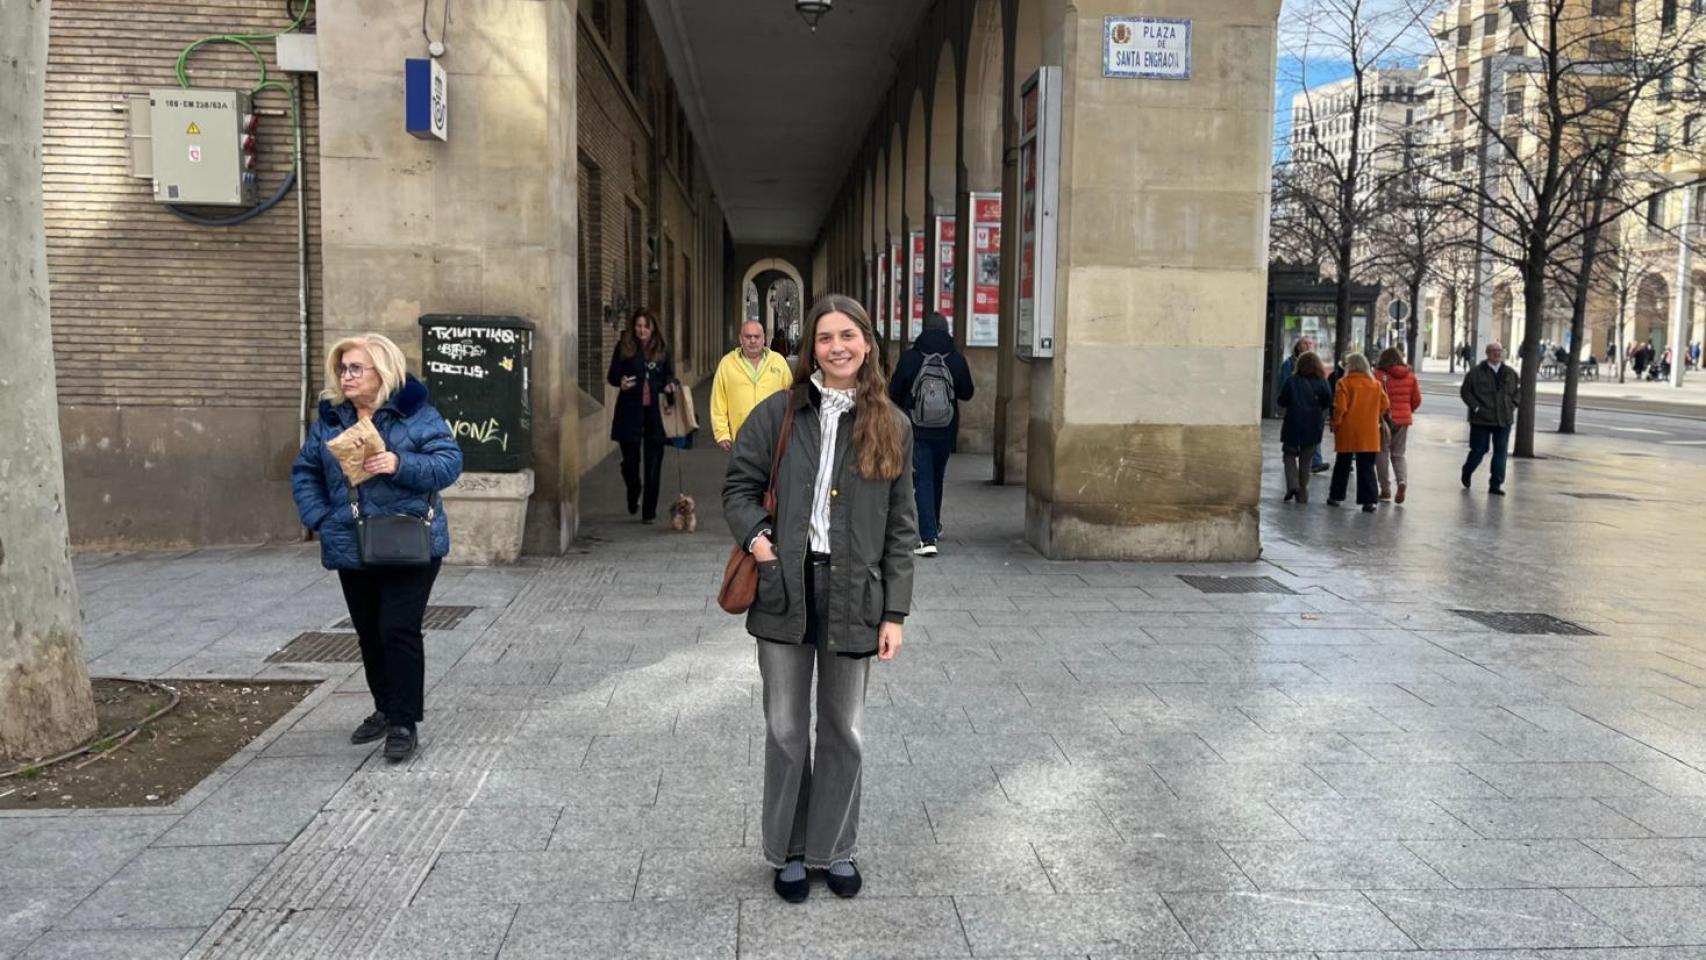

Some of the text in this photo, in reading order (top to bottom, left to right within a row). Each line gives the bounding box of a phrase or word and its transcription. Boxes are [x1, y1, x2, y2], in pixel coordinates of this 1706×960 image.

[1143, 26, 1176, 39] PLAZA
[1157, 40, 1166, 48] DE
[1116, 50, 1141, 66] SANTA
